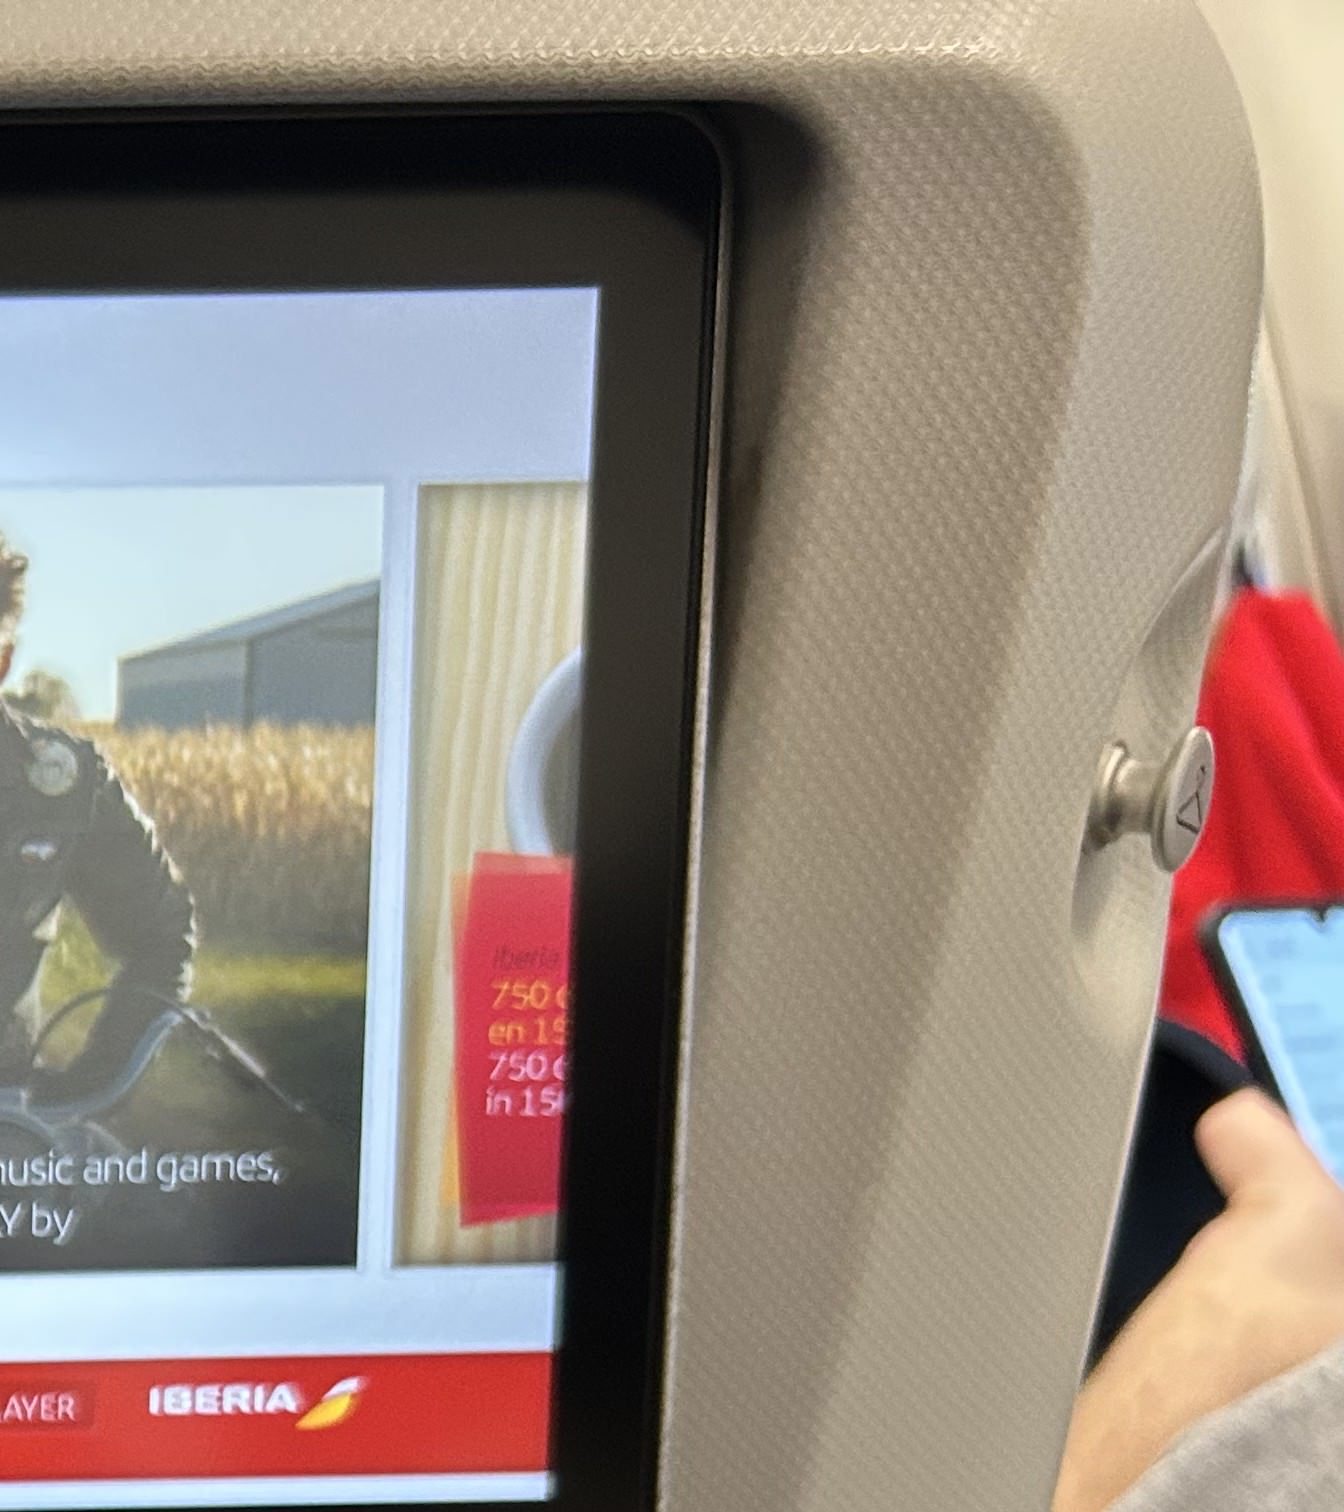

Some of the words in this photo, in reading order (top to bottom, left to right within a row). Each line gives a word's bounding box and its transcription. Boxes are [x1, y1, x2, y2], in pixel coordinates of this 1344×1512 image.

[491, 977, 550, 1011] 750
[487, 1022, 526, 1047] en
[488, 1049, 548, 1083] 750
[486, 1085, 513, 1118] in
[83, 1145, 148, 1185] and
[156, 1149, 284, 1193] games,
[31, 1200, 76, 1246] by
[148, 1382, 302, 1417] IBERIA
